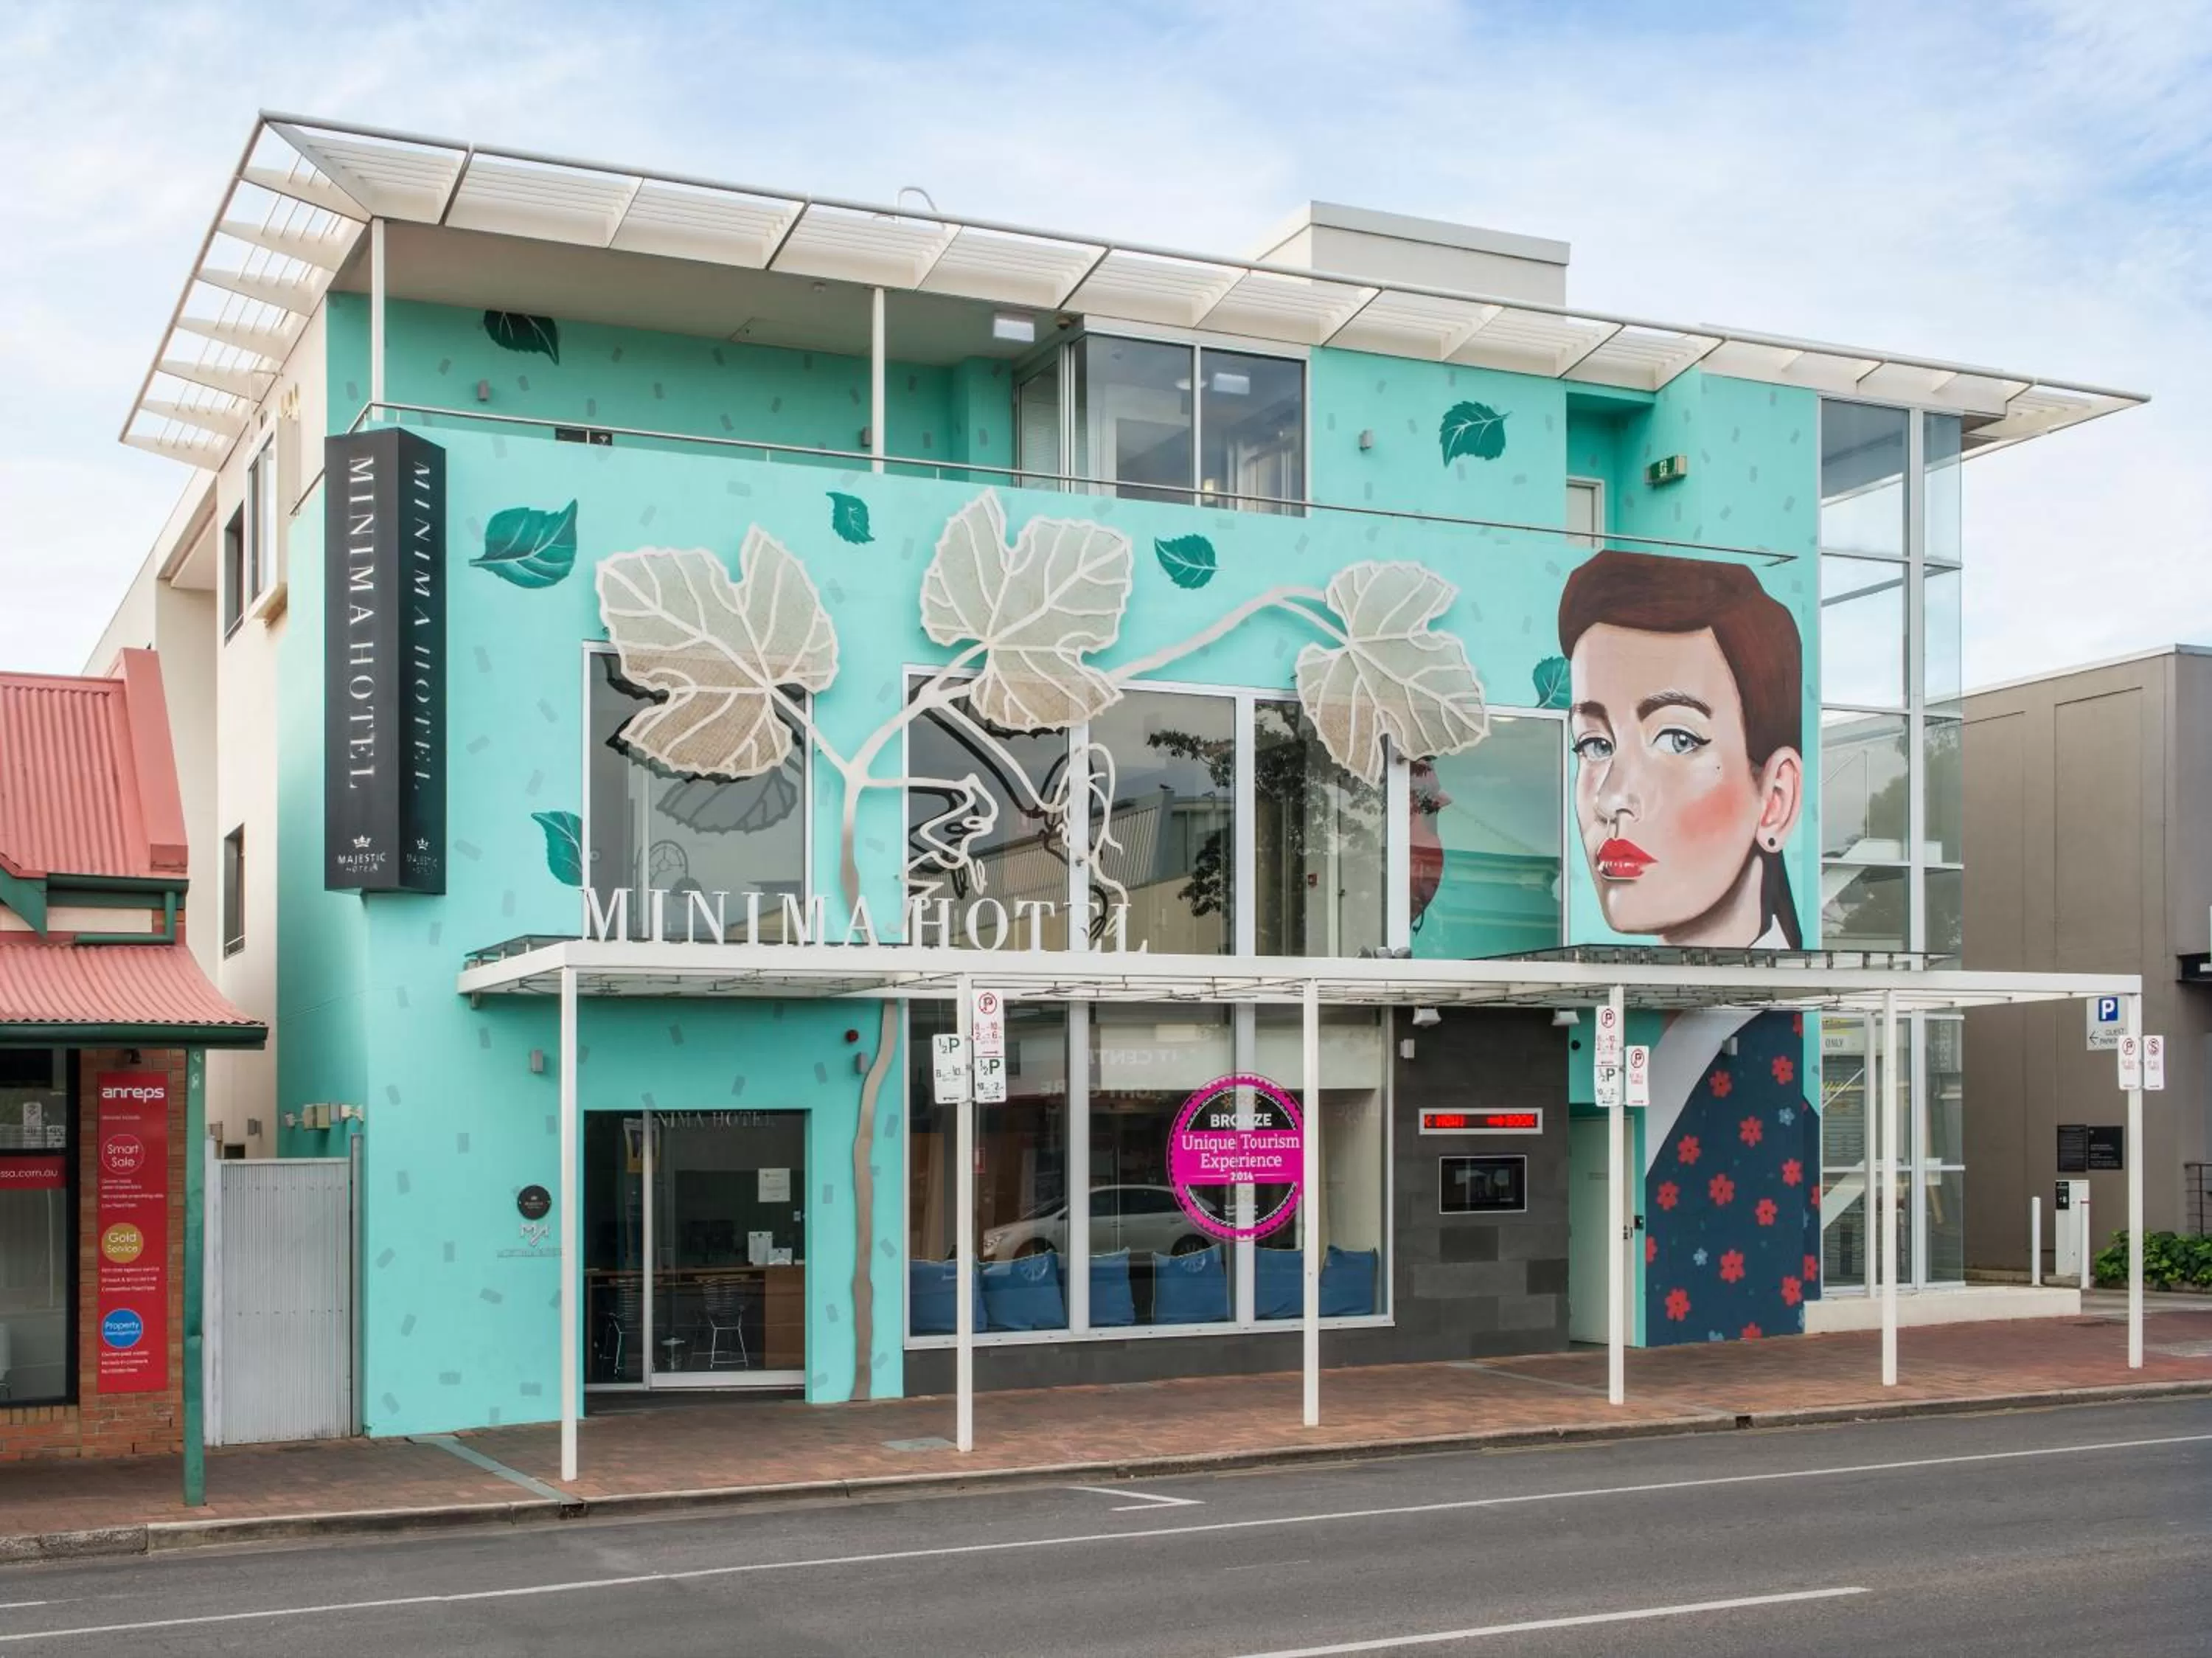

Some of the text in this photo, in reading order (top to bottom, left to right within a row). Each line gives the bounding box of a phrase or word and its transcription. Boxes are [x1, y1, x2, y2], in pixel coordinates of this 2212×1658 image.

[349, 457, 375, 789] MINIMA HOTEL
[414, 460, 432, 791] MINIMA HOTEL
[337, 852, 387, 865] MAJESTIC
[578, 887, 880, 948] MINIMA
[2101, 999, 2115, 1020] P
[1825, 1038, 1844, 1048] ONLY
[102, 1087, 164, 1103] anreps
[1210, 1113, 1273, 1128] BROZE
[107, 1143, 139, 1155] Smart
[1181, 1133, 1301, 1154] Unique Tourism
[111, 1156, 136, 1168] Sale
[1200, 1152, 1283, 1171] Experience
[1229, 1171, 1254, 1182] 2014
[108, 1232, 136, 1244] Gold
[106, 1244, 139, 1254] Service
[105, 1321, 139, 1331] Property
